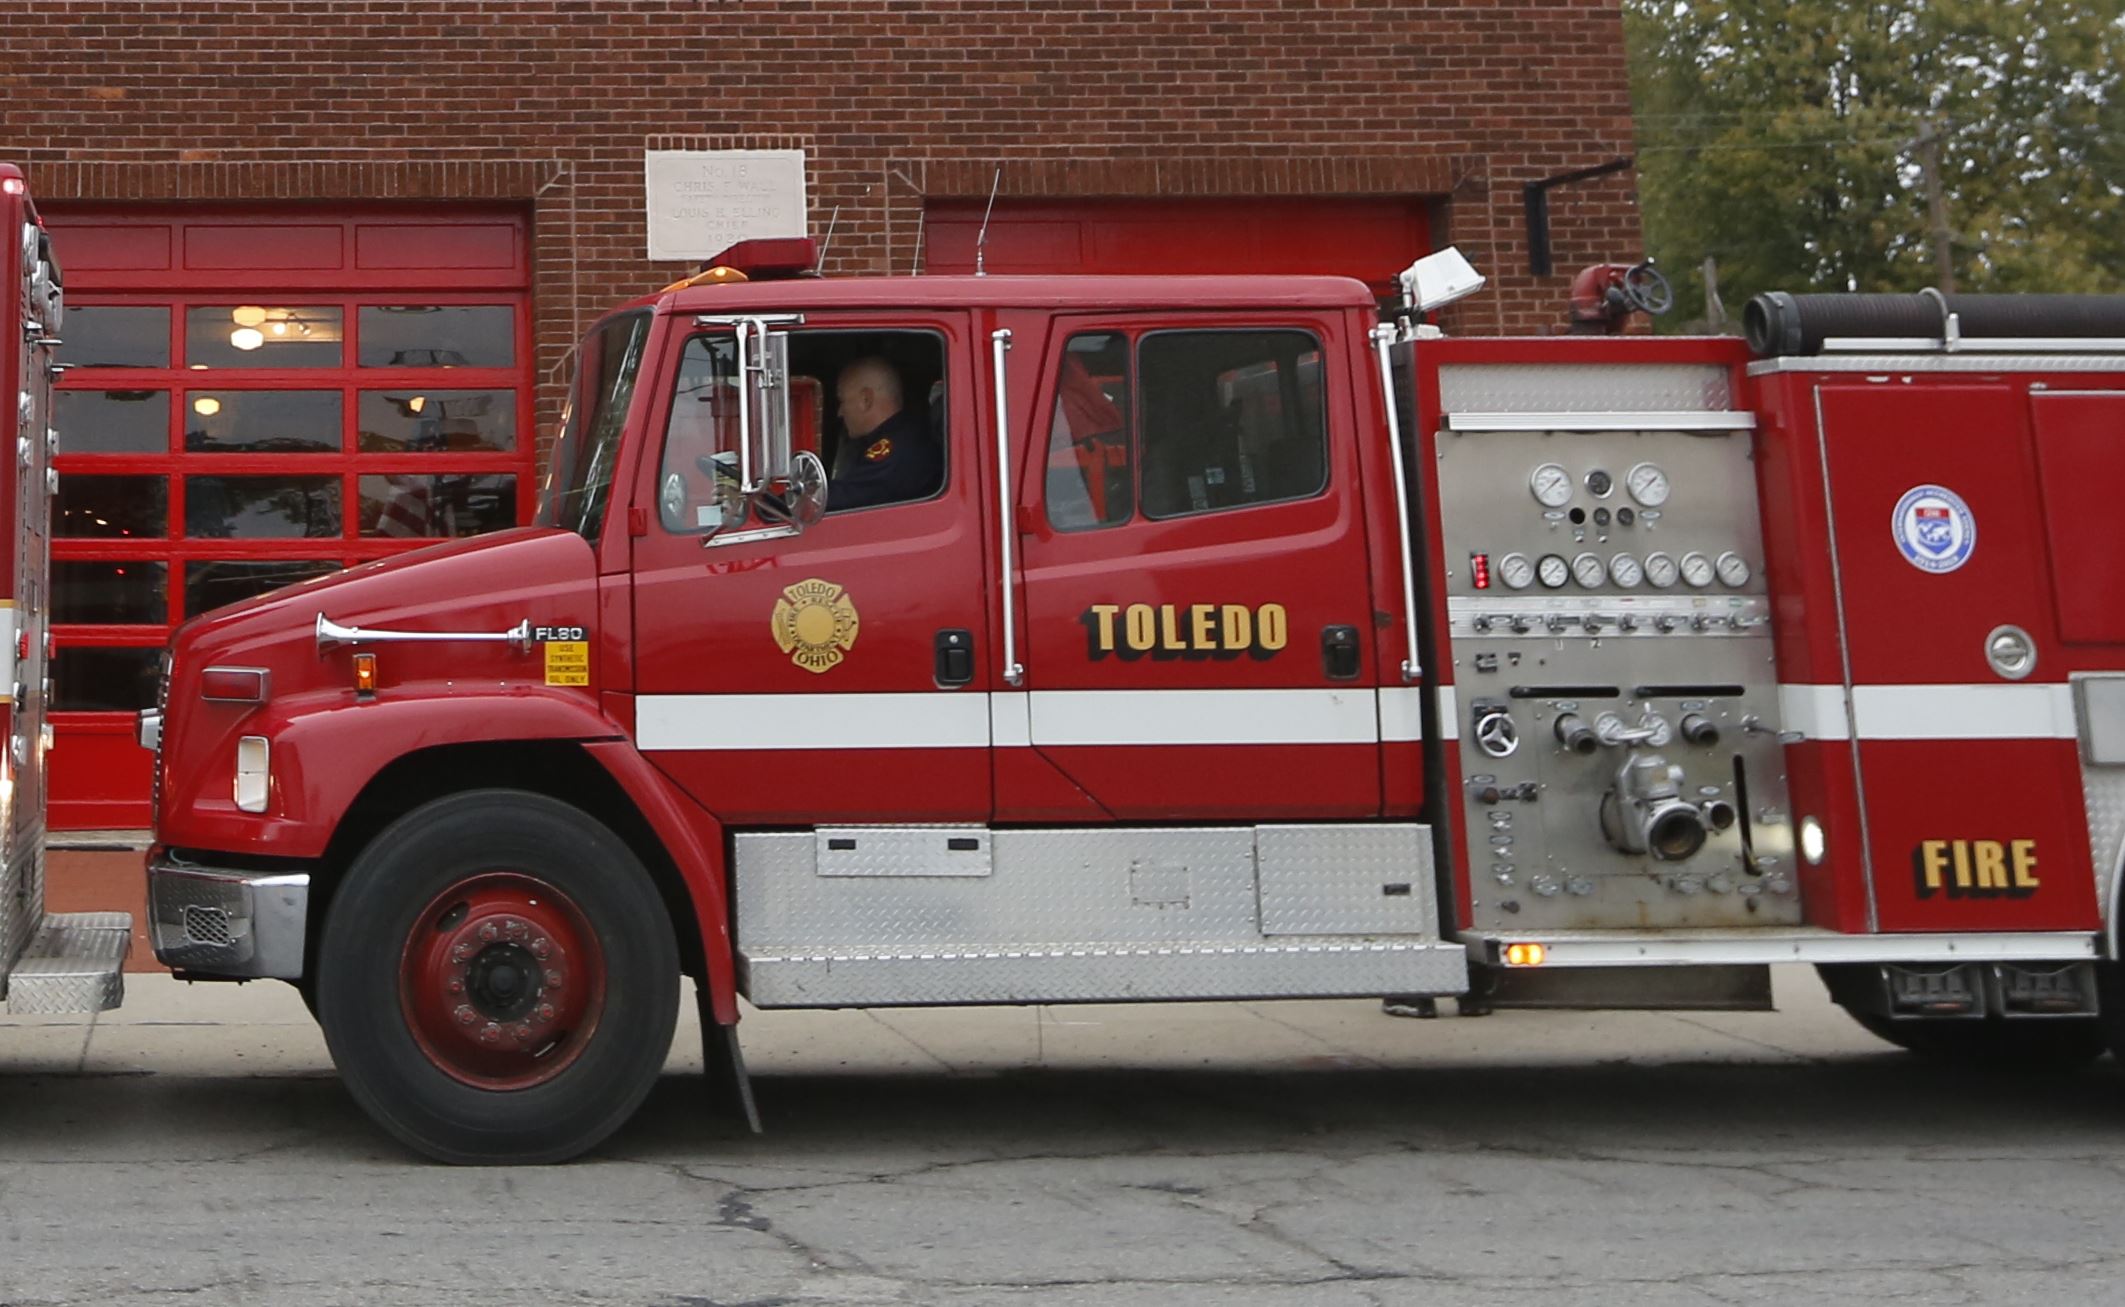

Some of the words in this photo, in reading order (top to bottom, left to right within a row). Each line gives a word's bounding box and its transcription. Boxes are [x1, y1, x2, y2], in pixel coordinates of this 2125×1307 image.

[788, 583, 836, 600] TOLEDO
[535, 627, 583, 640] FL80
[1089, 603, 1288, 652] TOLEDO
[559, 644, 574, 652] USE
[797, 650, 838, 667] OHIO
[565, 675, 586, 683] ONLY
[1920, 839, 2040, 889] FIRE
